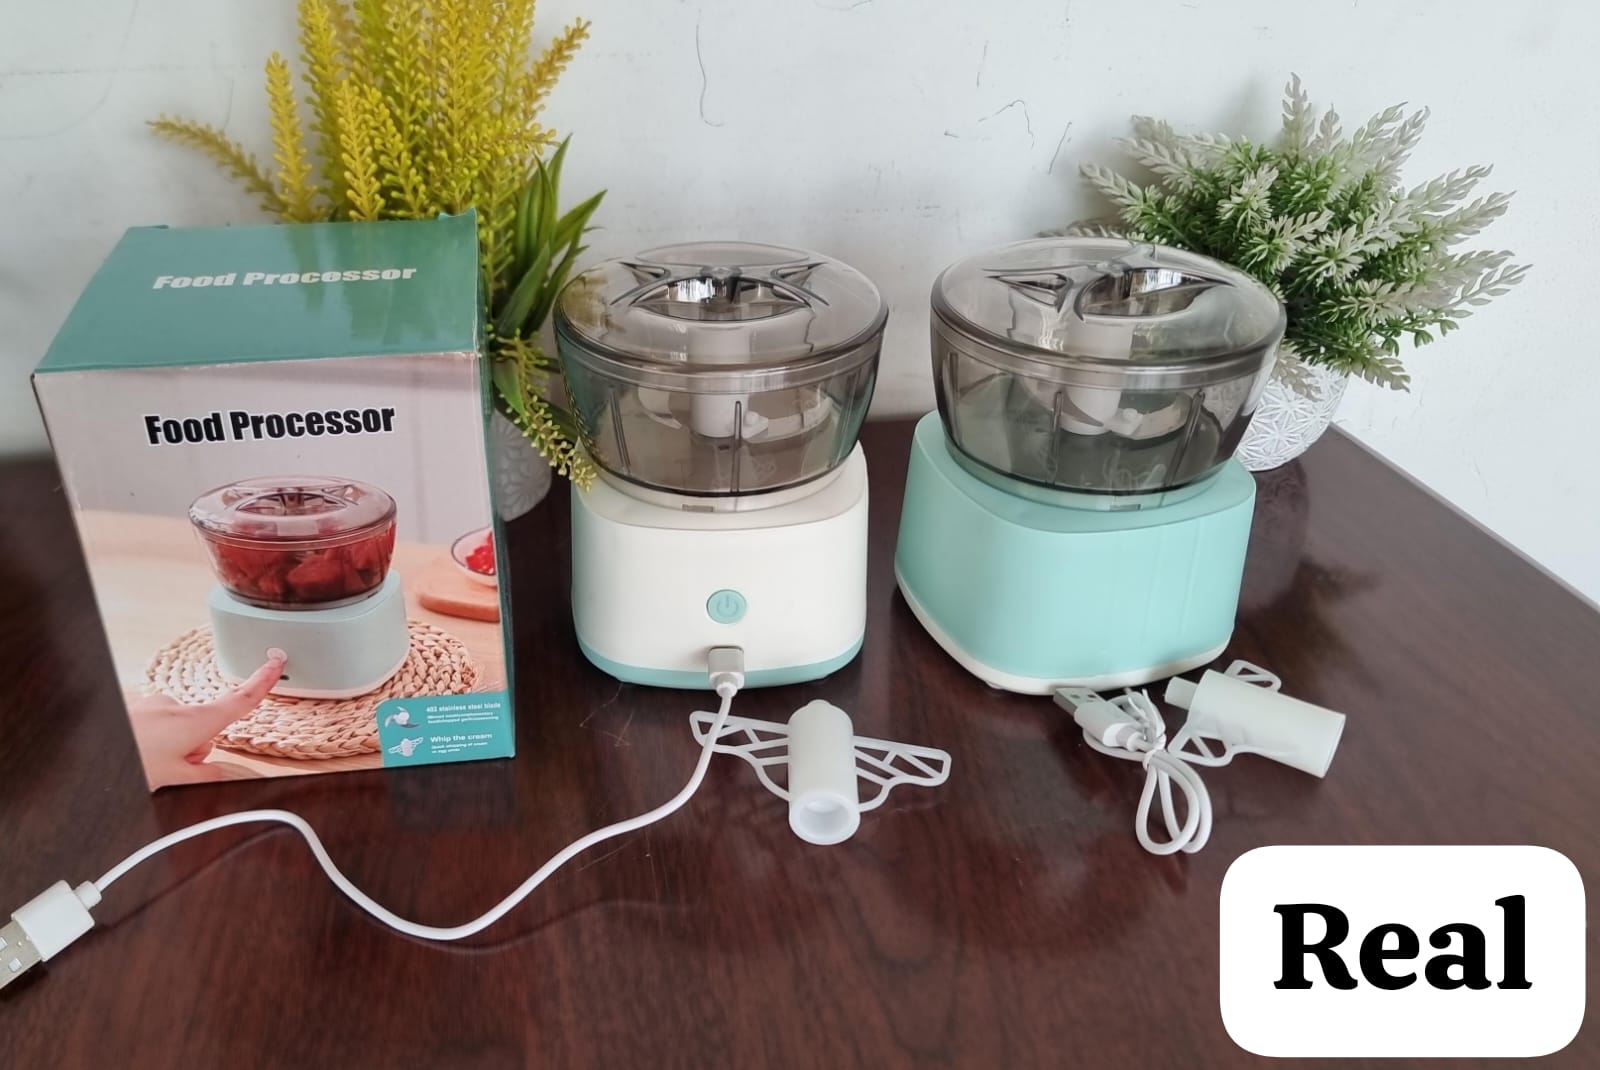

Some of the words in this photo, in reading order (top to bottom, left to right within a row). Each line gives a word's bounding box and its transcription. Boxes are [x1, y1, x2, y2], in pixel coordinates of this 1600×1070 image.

[153, 272, 237, 290] Food
[243, 268, 417, 286] Processor
[144, 412, 226, 445] Food
[229, 406, 396, 441] Processor
[430, 735, 451, 743] Whip
